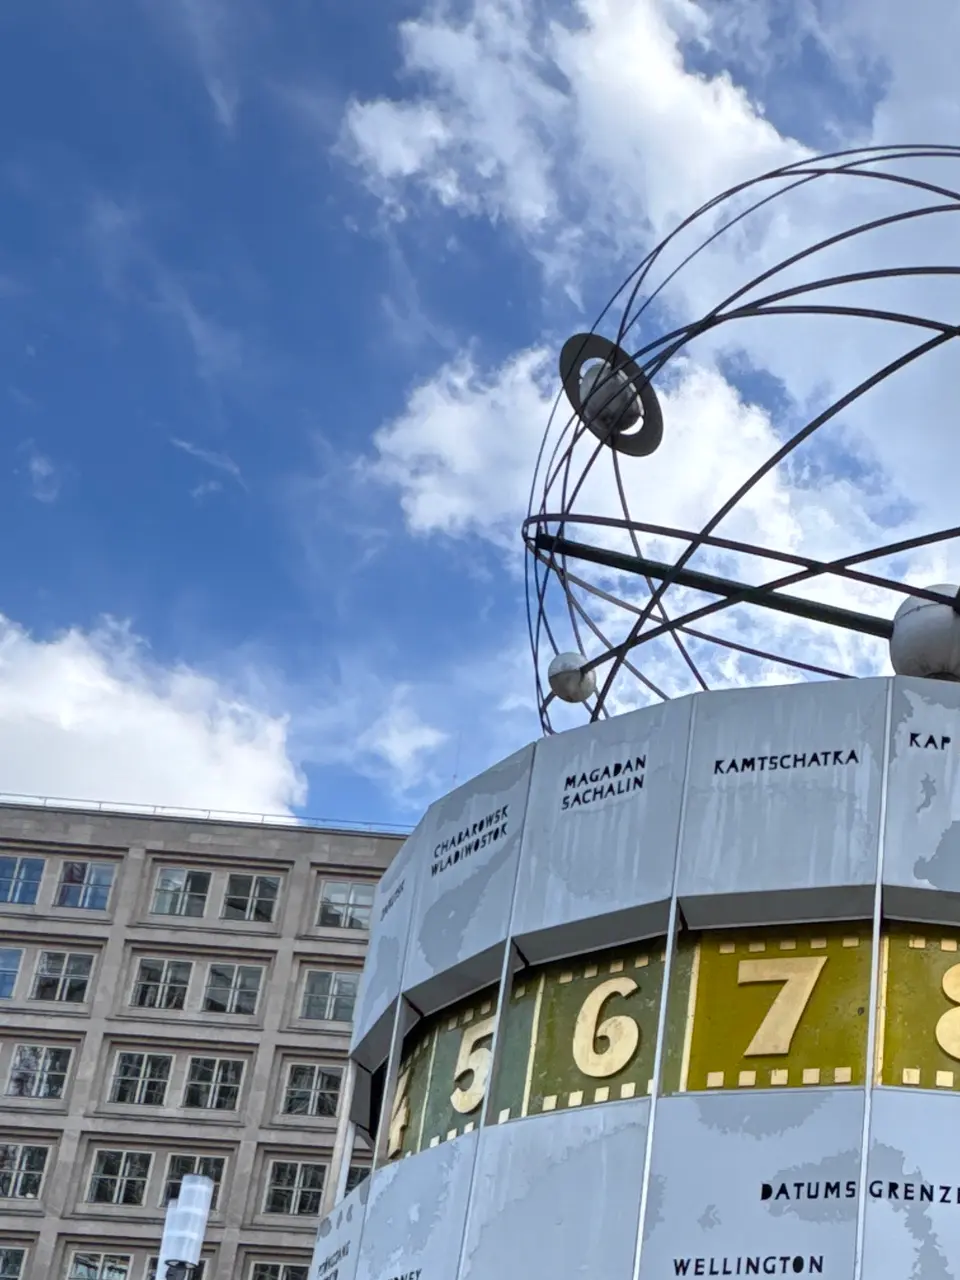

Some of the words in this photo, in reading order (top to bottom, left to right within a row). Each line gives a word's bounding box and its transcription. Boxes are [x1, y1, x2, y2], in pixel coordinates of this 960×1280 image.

[908, 732, 951, 751] KAP
[564, 754, 647, 791] MAGADAN
[714, 749, 860, 775] KAMTSCHATKA
[561, 774, 645, 811] SACHALIN
[430, 822, 508, 877] WLADIWOSTOK
[433, 804, 510, 858] CHABAROWSK
[450, 1015, 494, 1114] 5
[572, 976, 641, 1078] 6
[738, 955, 828, 1057] 7
[673, 1255, 824, 1276] WELLINGTON
